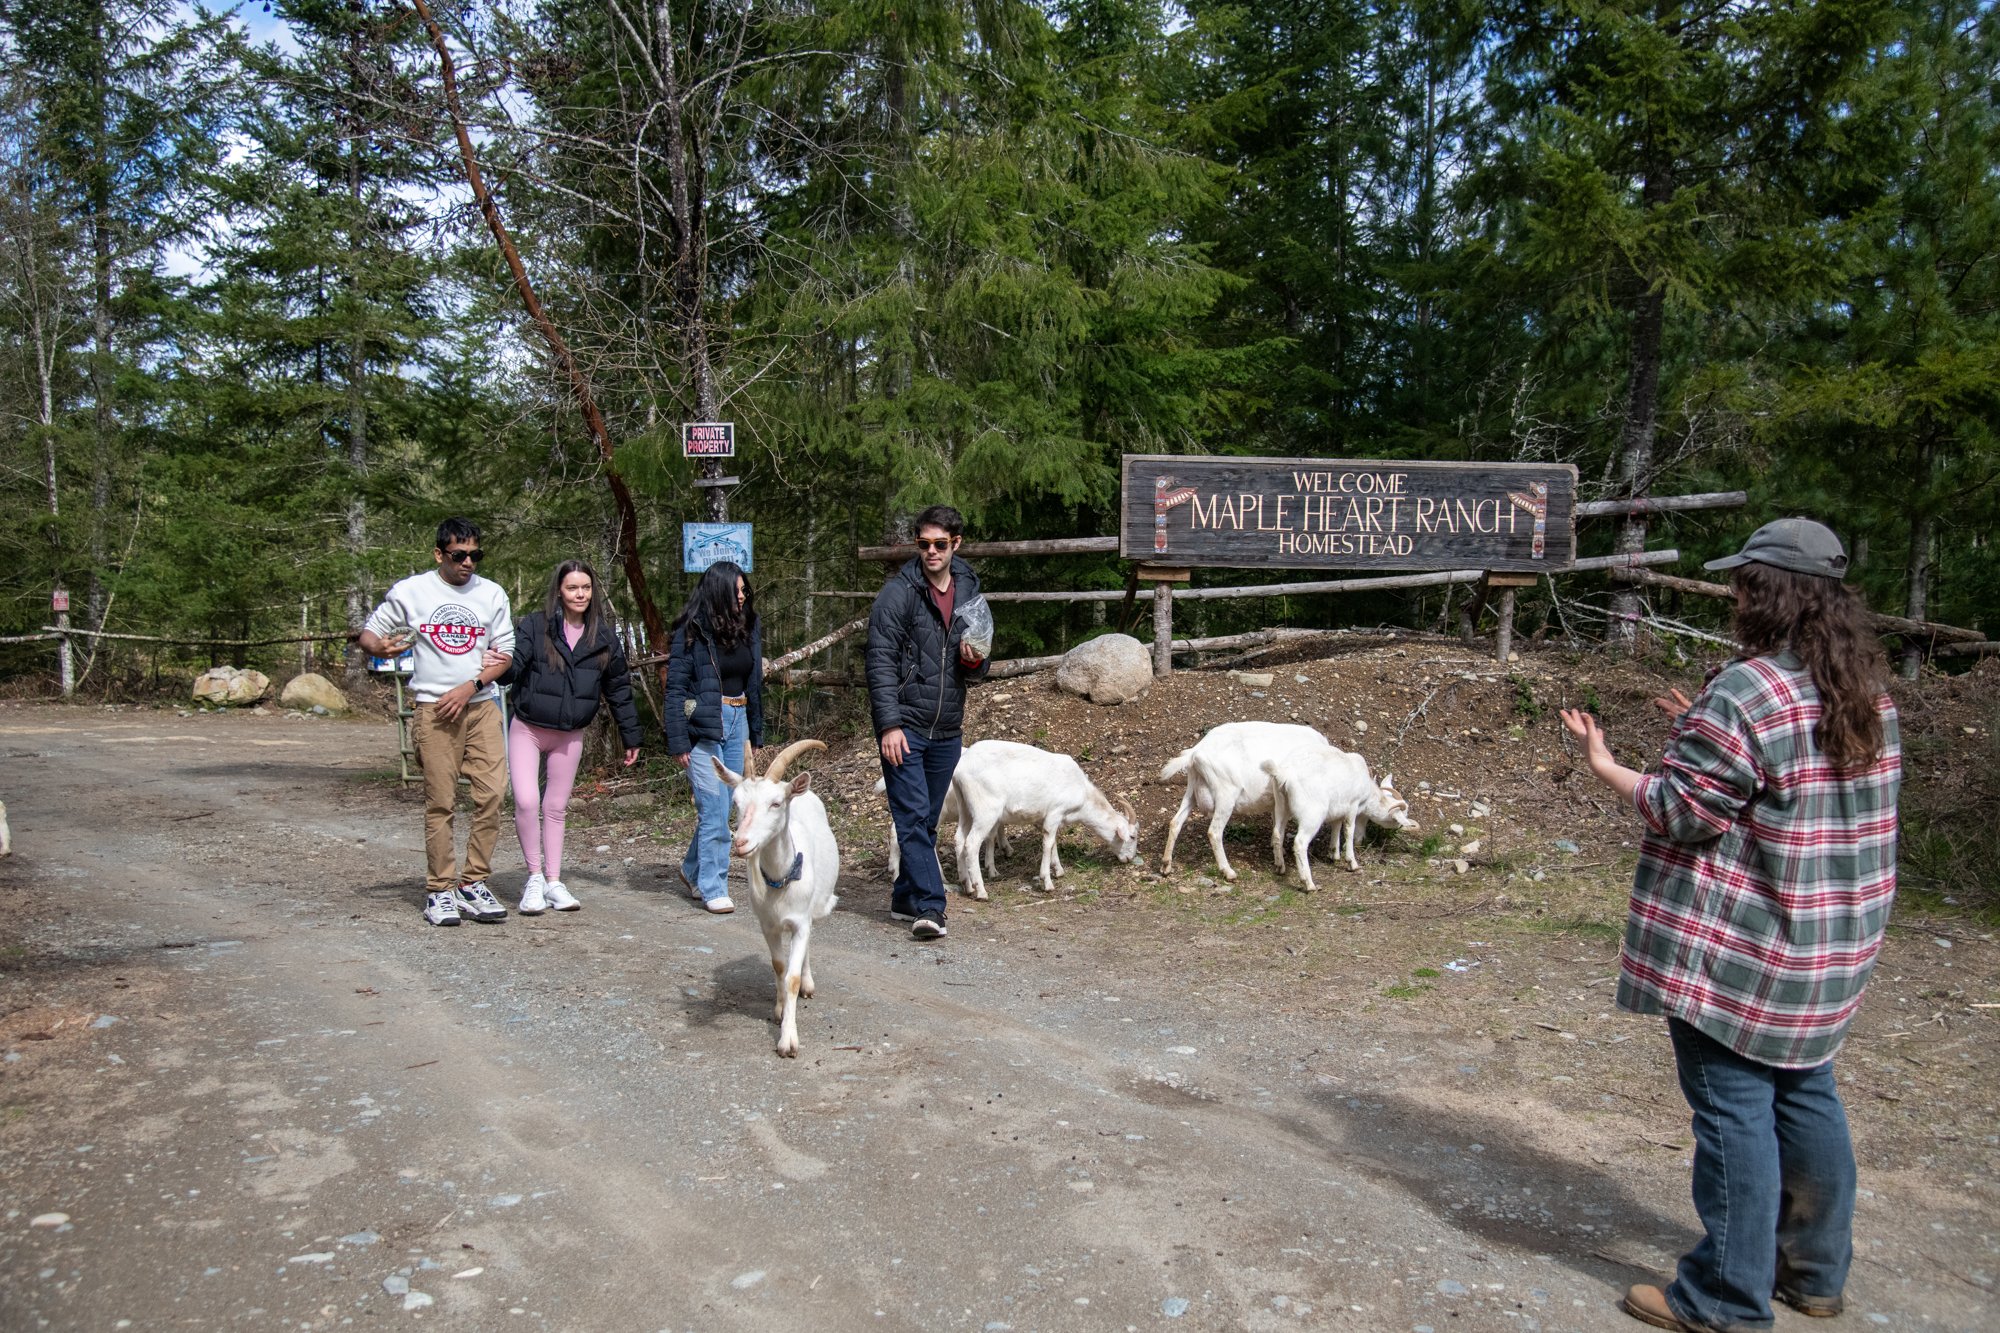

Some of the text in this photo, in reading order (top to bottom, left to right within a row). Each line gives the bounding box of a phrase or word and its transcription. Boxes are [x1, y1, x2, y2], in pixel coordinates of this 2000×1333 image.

[692, 427, 725, 440] PRIVATE
[687, 440, 730, 453] PROPERTY
[1292, 471, 1408, 494] WELCOME
[1190, 493, 1516, 534] MAPLE HEART RANCH
[1278, 532, 1413, 556] HOMESTEAD
[432, 606, 458, 623] CANADIAN
[458, 607, 477, 625] ROCKIES
[425, 625, 483, 635] BANFF
[445, 645, 469, 654] NATIONAL
